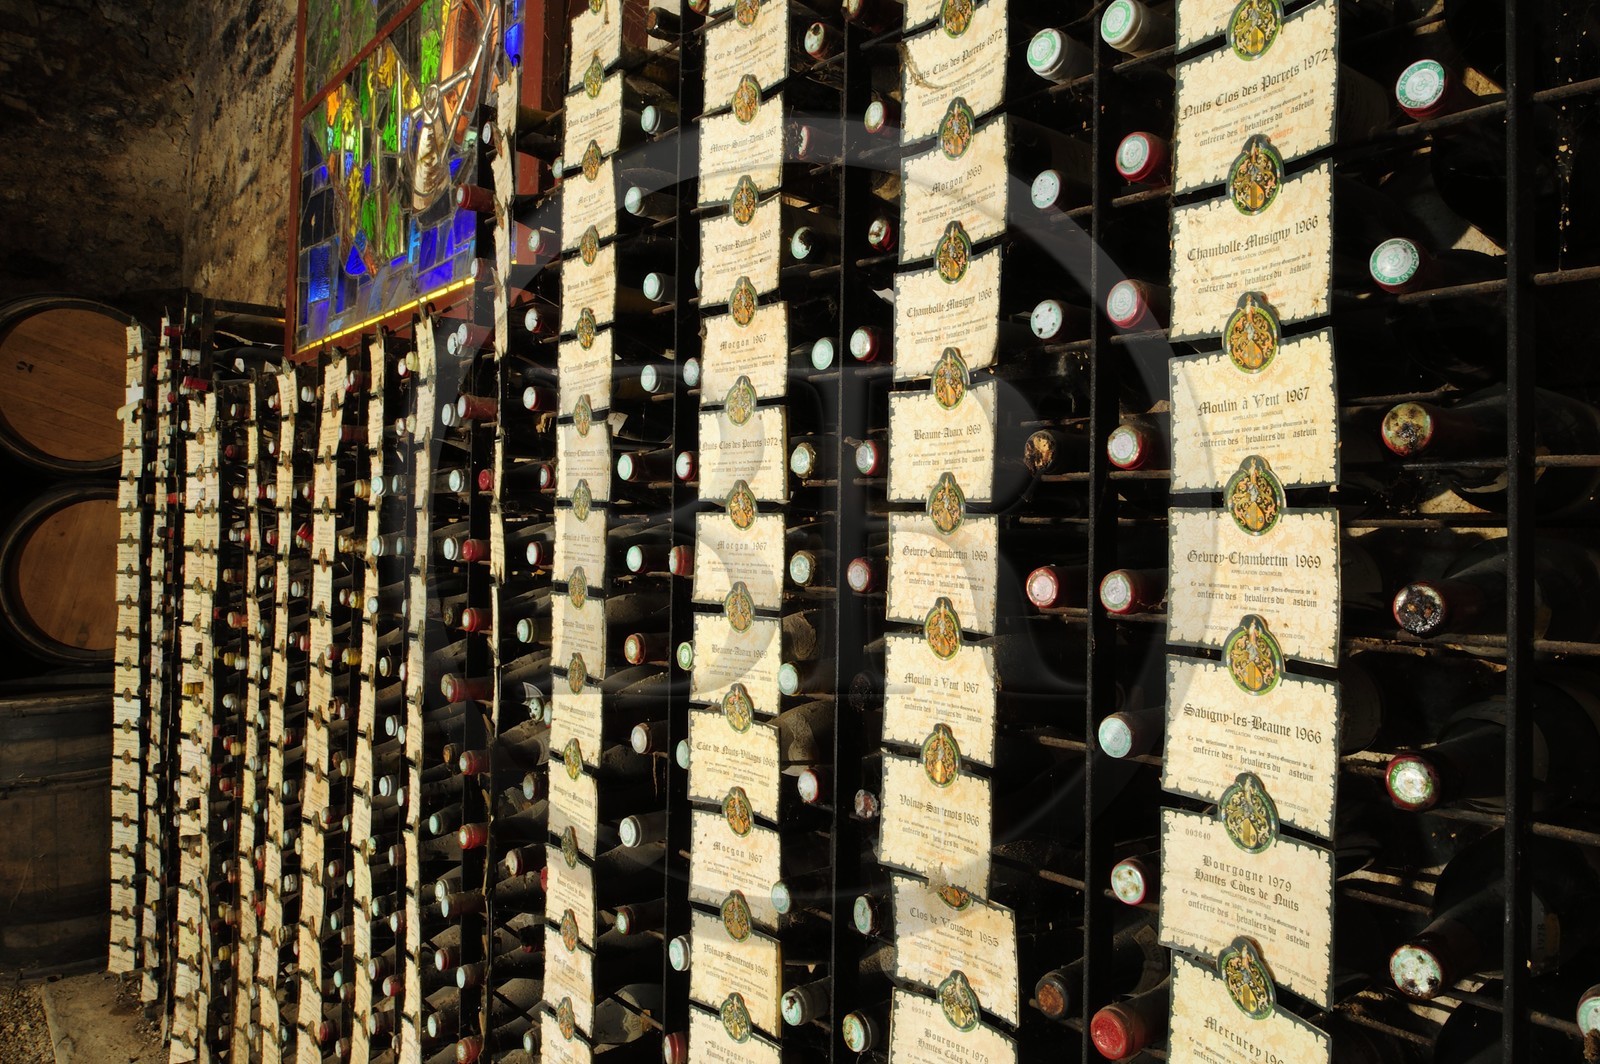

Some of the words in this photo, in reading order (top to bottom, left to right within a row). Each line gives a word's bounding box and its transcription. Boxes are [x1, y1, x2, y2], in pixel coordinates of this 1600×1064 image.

[1181, 101, 1211, 120] Nuits
[1216, 90, 1239, 106] Clos
[1242, 83, 1258, 97] des
[1261, 64, 1299, 92] Porrets
[1303, 48, 1329, 71] 1972
[932, 175, 963, 193] Morgon
[1187, 228, 1290, 261] Chambolle-Musigny
[1295, 216, 1318, 235] 1966
[978, 288, 992, 302] 1966
[720, 339, 749, 351] Morgon
[1197, 401, 1237, 417] Moulin
[1242, 397, 1248, 410] à
[1252, 392, 1280, 408] Vent
[1286, 387, 1310, 403] 1967
[1227, 436, 1239, 445] des
[717, 540, 749, 551] Morgon
[752, 542, 767, 551] 1967
[972, 550, 988, 561] 1969
[1187, 549, 1288, 567] Gevrey-Chambertin
[1295, 554, 1321, 569] 1969
[1225, 591, 1236, 600] des
[1276, 596, 1285, 605] du
[904, 673, 931, 687] Moulin
[941, 677, 958, 690] Vent
[963, 681, 979, 694] 1967
[1183, 702, 1291, 737] Savigny-les-Beaune
[1295, 726, 1321, 744] 1966
[1221, 748, 1233, 761] des
[1272, 763, 1281, 773] du
[964, 811, 980, 827] 1966
[713, 841, 744, 857] Morgon
[748, 851, 762, 863] 1967
[1202, 855, 1264, 884] Bourgogne
[1268, 875, 1292, 892] 1979
[1194, 868, 1226, 887] Hautes
[1230, 879, 1256, 897] Côtes
[1259, 887, 1268, 900] de
[1273, 893, 1299, 912] Nuits
[910, 907, 928, 920] Clos
[930, 914, 937, 925] de
[979, 931, 999, 947] 1955
[1217, 904, 1229, 918] des
[1268, 924, 1277, 935] du
[924, 1028, 969, 1055] Bourgogne
[972, 1047, 989, 1064] 1979
[1203, 1016, 1261, 1057] Mercurey
